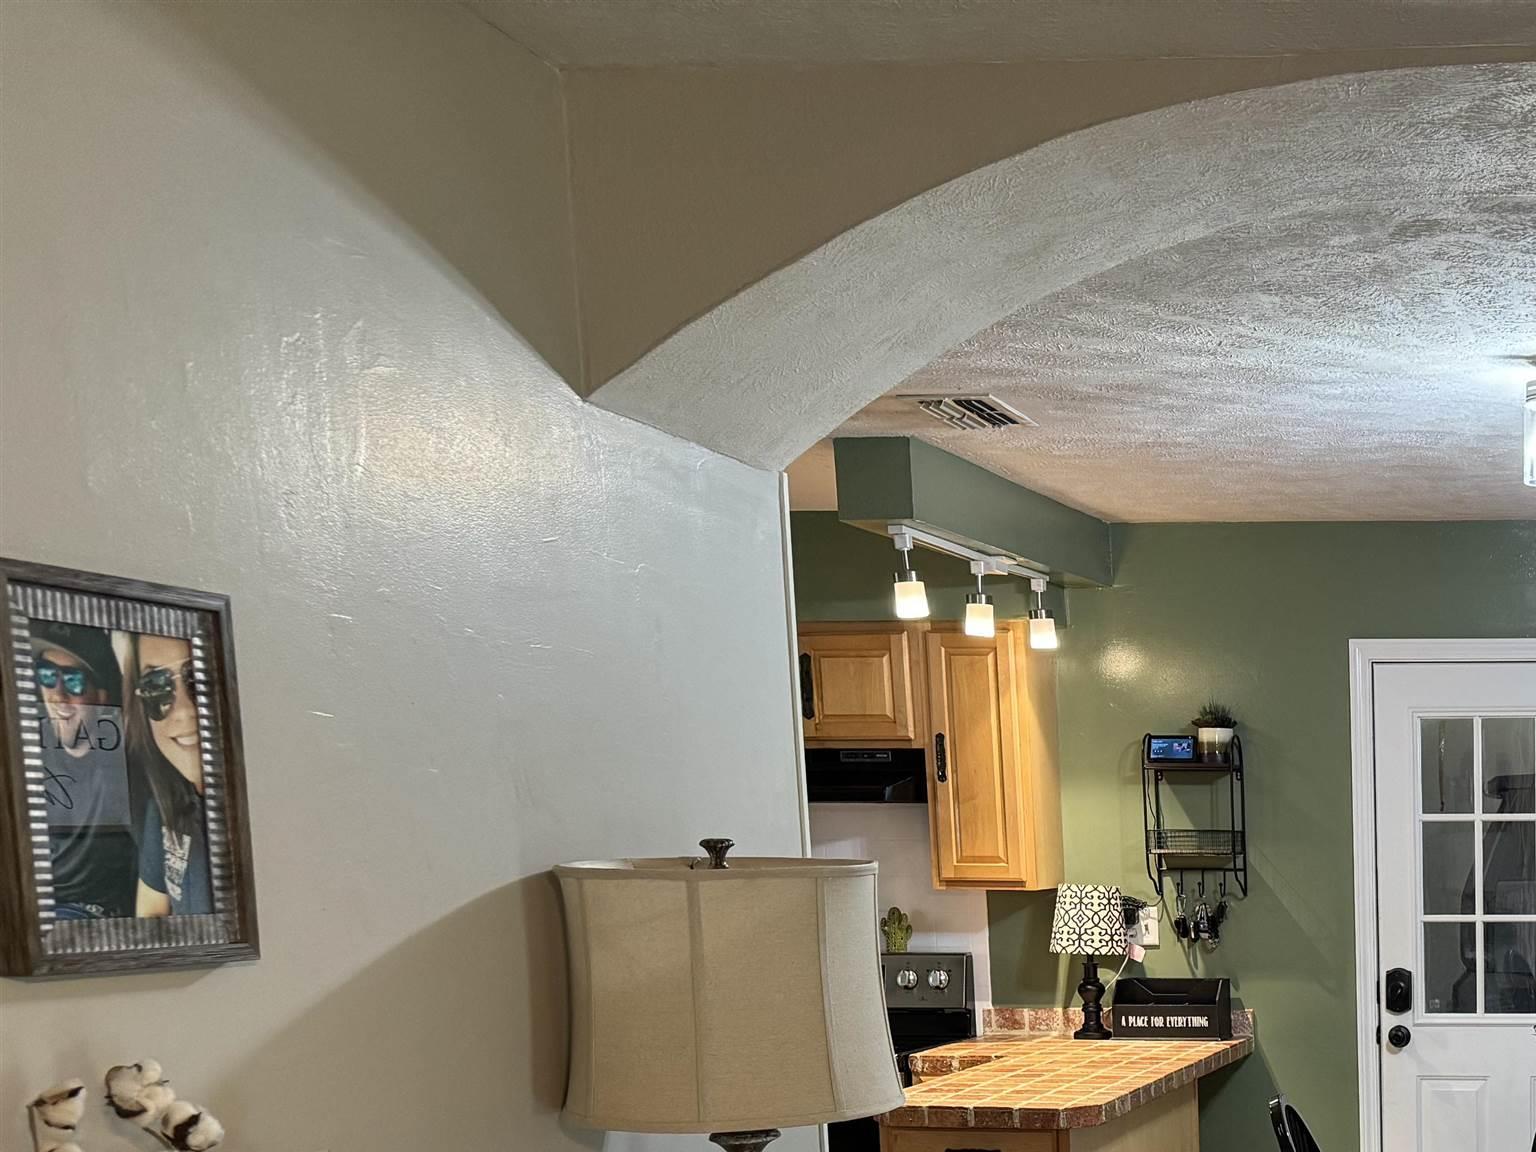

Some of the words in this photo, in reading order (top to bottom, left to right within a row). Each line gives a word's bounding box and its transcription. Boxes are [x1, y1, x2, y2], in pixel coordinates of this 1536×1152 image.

[1121, 1015, 1127, 1027] A
[1128, 1015, 1149, 1028] PLACE
[1150, 1015, 1165, 1028] FOR
[1166, 1015, 1209, 1028] EVERYTHING
